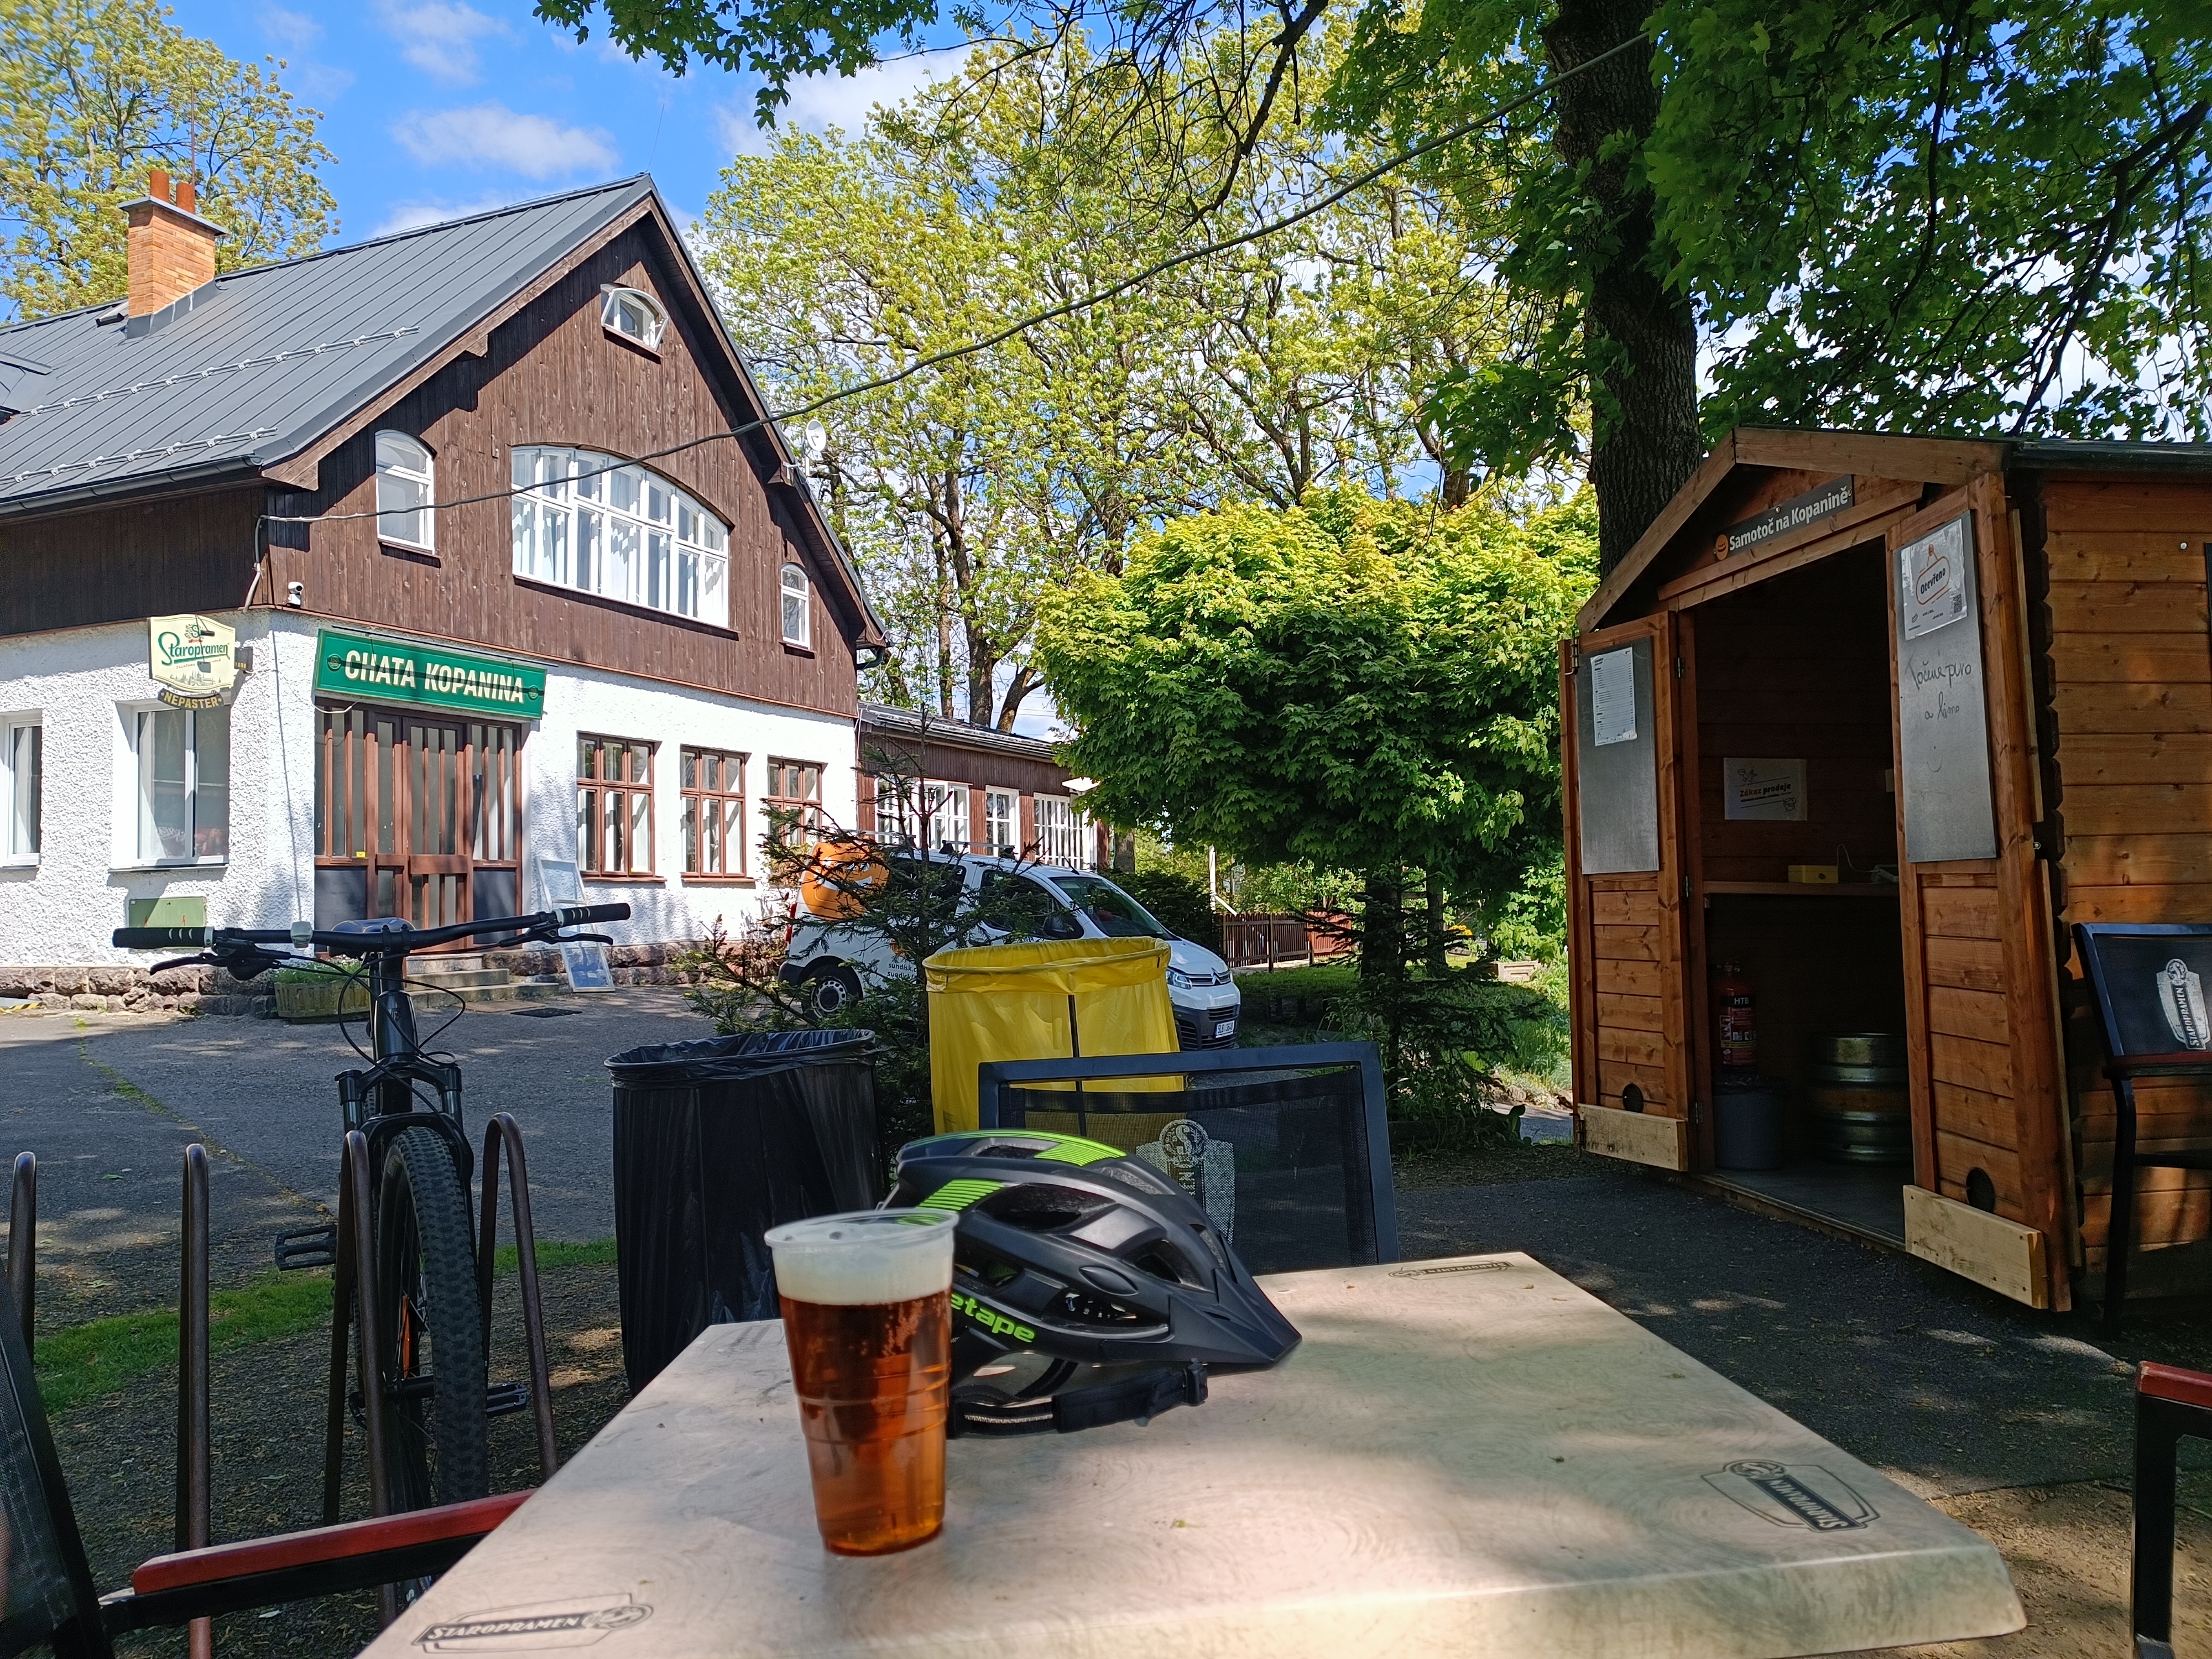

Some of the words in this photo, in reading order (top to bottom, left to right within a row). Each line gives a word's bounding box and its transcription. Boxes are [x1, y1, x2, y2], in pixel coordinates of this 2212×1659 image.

[1729, 518, 1774, 551] Samotoč
[1776, 515, 1790, 532] na
[1791, 486, 1848, 524] Kopanině
[1921, 568, 1946, 594] Otevřeno
[158, 632, 230, 666] Staropramen
[345, 650, 416, 688] CHATA
[424, 662, 524, 704] KOPANINA
[1945, 661, 1971, 689] pivo
[164, 692, 219, 709] NEPASTER
[1924, 711, 1934, 719] a
[1740, 789, 1762, 797] Zákaz
[1763, 782, 1791, 795] prodeje
[2176, 987, 2200, 1046] STAROPRAMEN
[950, 1293, 1035, 1343] etape
[1766, 1480, 1849, 1528] STAROPRAMEN
[427, 1617, 580, 1640] STAROPRAMEN
